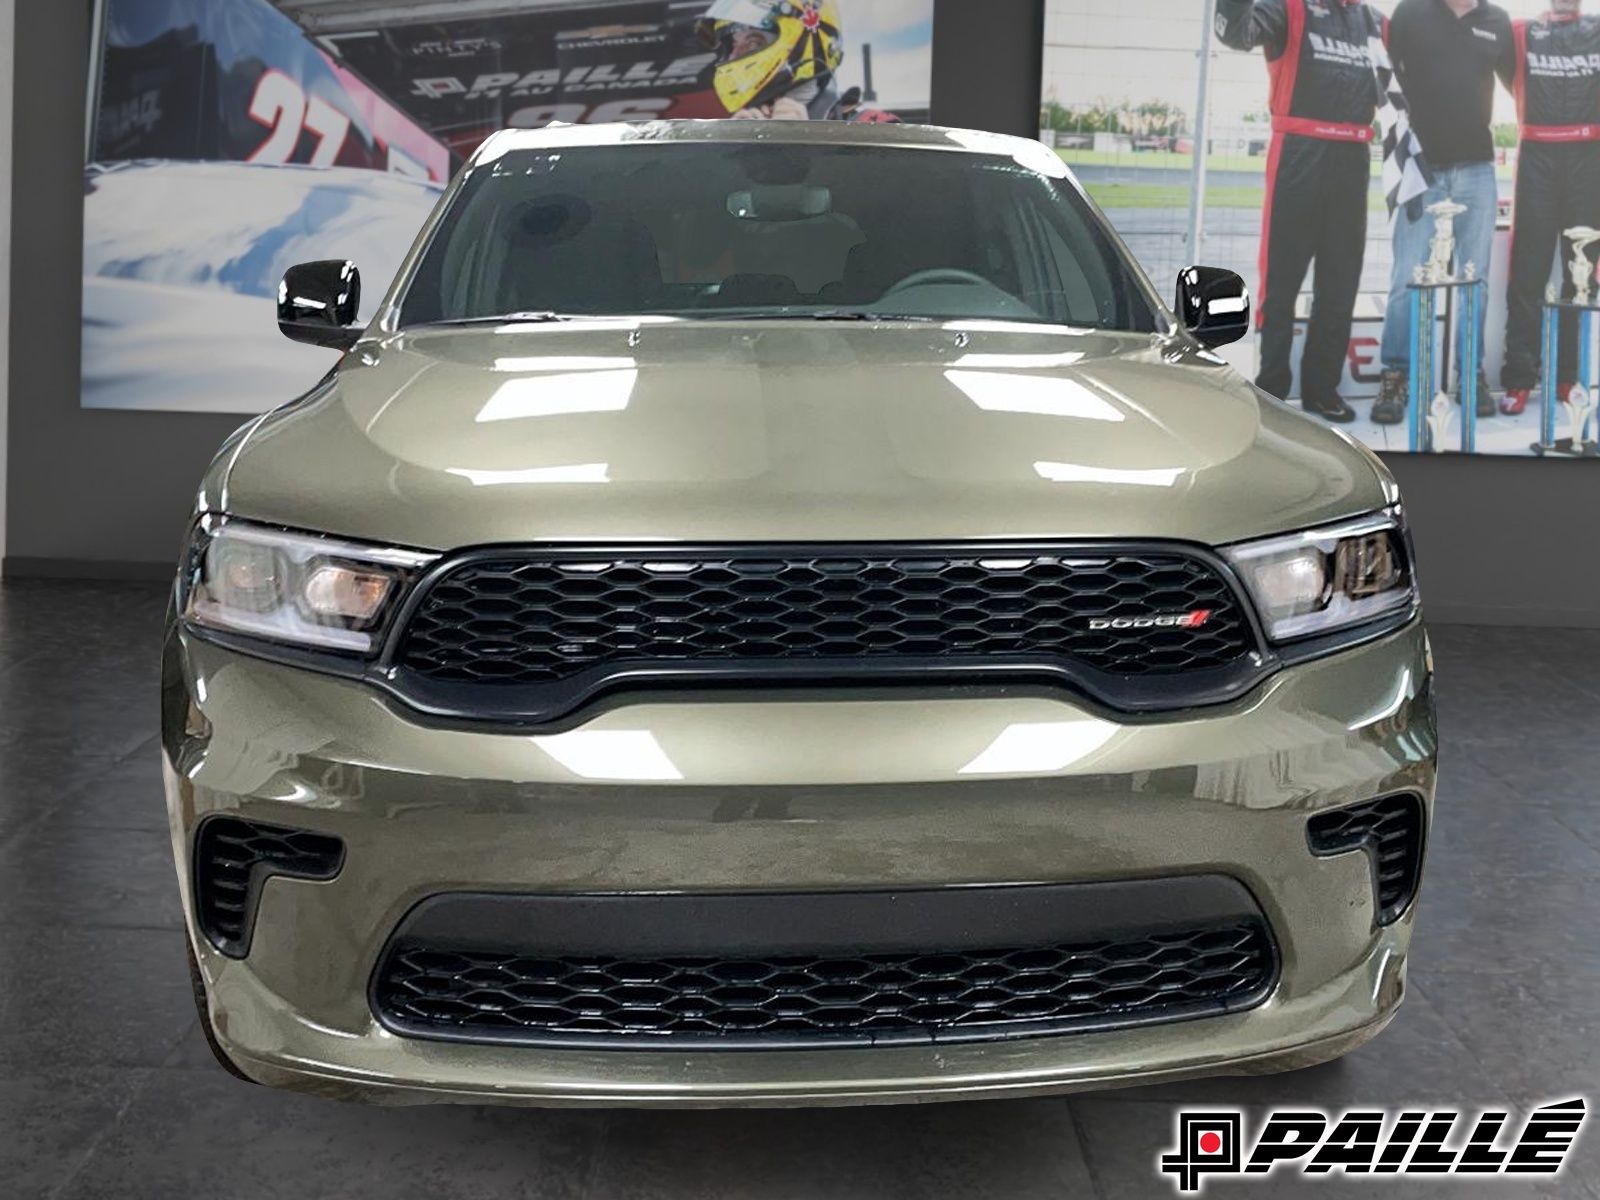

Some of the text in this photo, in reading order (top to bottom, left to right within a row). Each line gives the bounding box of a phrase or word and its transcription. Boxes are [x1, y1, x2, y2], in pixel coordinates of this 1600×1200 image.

[557, 35, 667, 50] CHEVROLET
[509, 86, 554, 97] AU
[563, 76, 698, 93] CANADA
[246, 68, 351, 169] 27
[1088, 615, 1193, 630] DODGE
